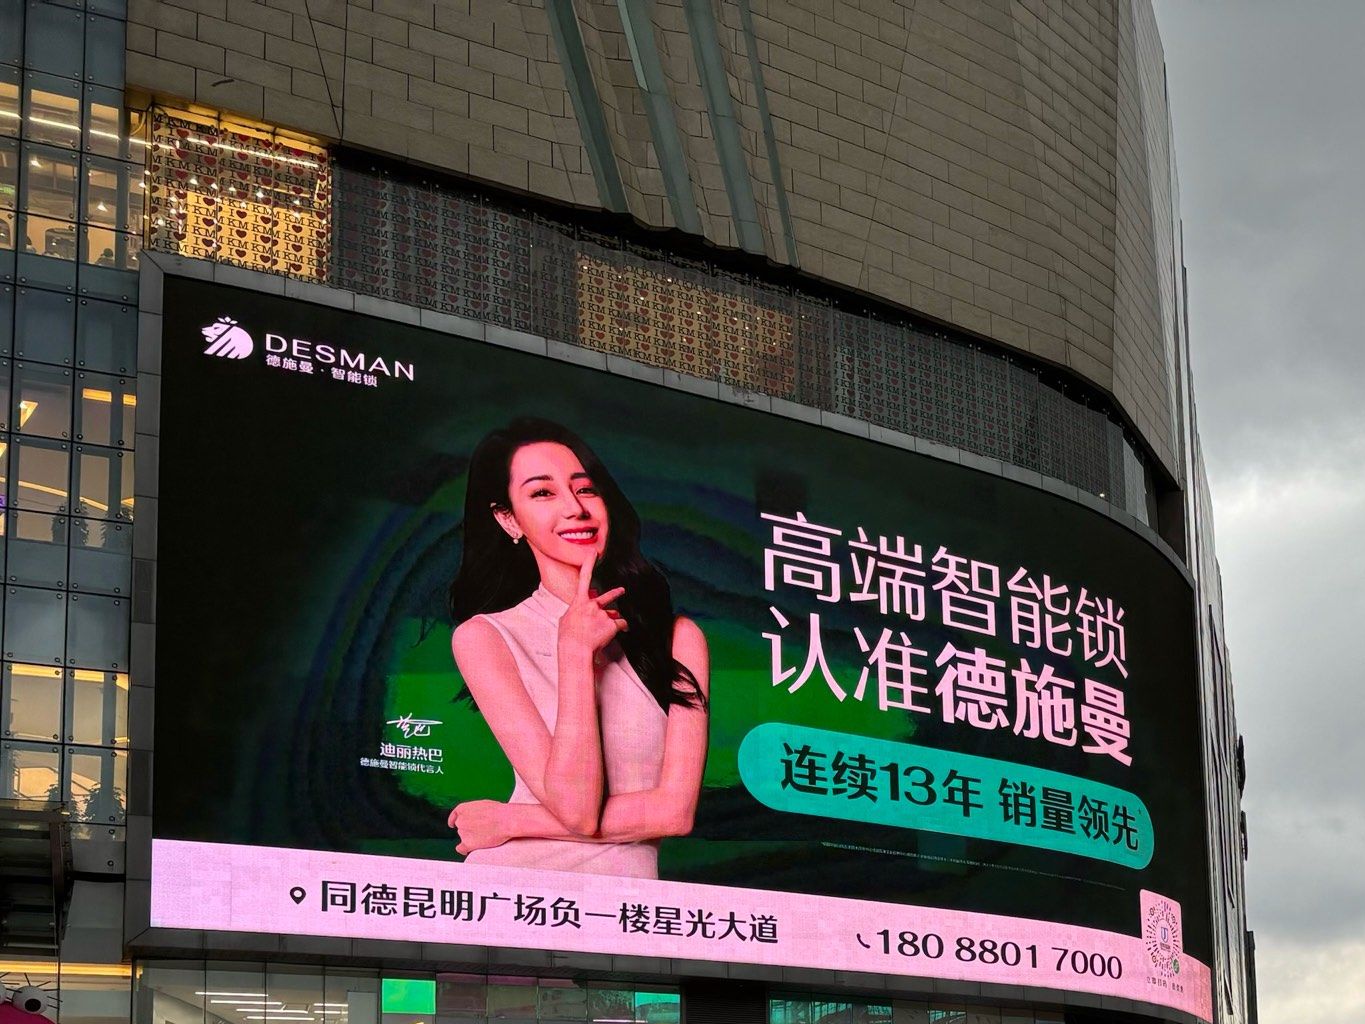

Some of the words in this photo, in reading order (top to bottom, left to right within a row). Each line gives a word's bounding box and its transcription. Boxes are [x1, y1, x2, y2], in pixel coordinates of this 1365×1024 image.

[265, 334, 414, 381] DESMAN
[760, 511, 1129, 678] 高端智能锁
[762, 606, 1133, 766] 认准德施曼
[380, 742, 443, 762] 迪丽热巴
[780, 744, 984, 817] 连续13年
[321, 880, 779, 944] 同德昆明广场负一楼星光大道
[878, 929, 943, 959] 180
[956, 937, 1038, 969] 8801
[1051, 945, 1122, 979] 7000
